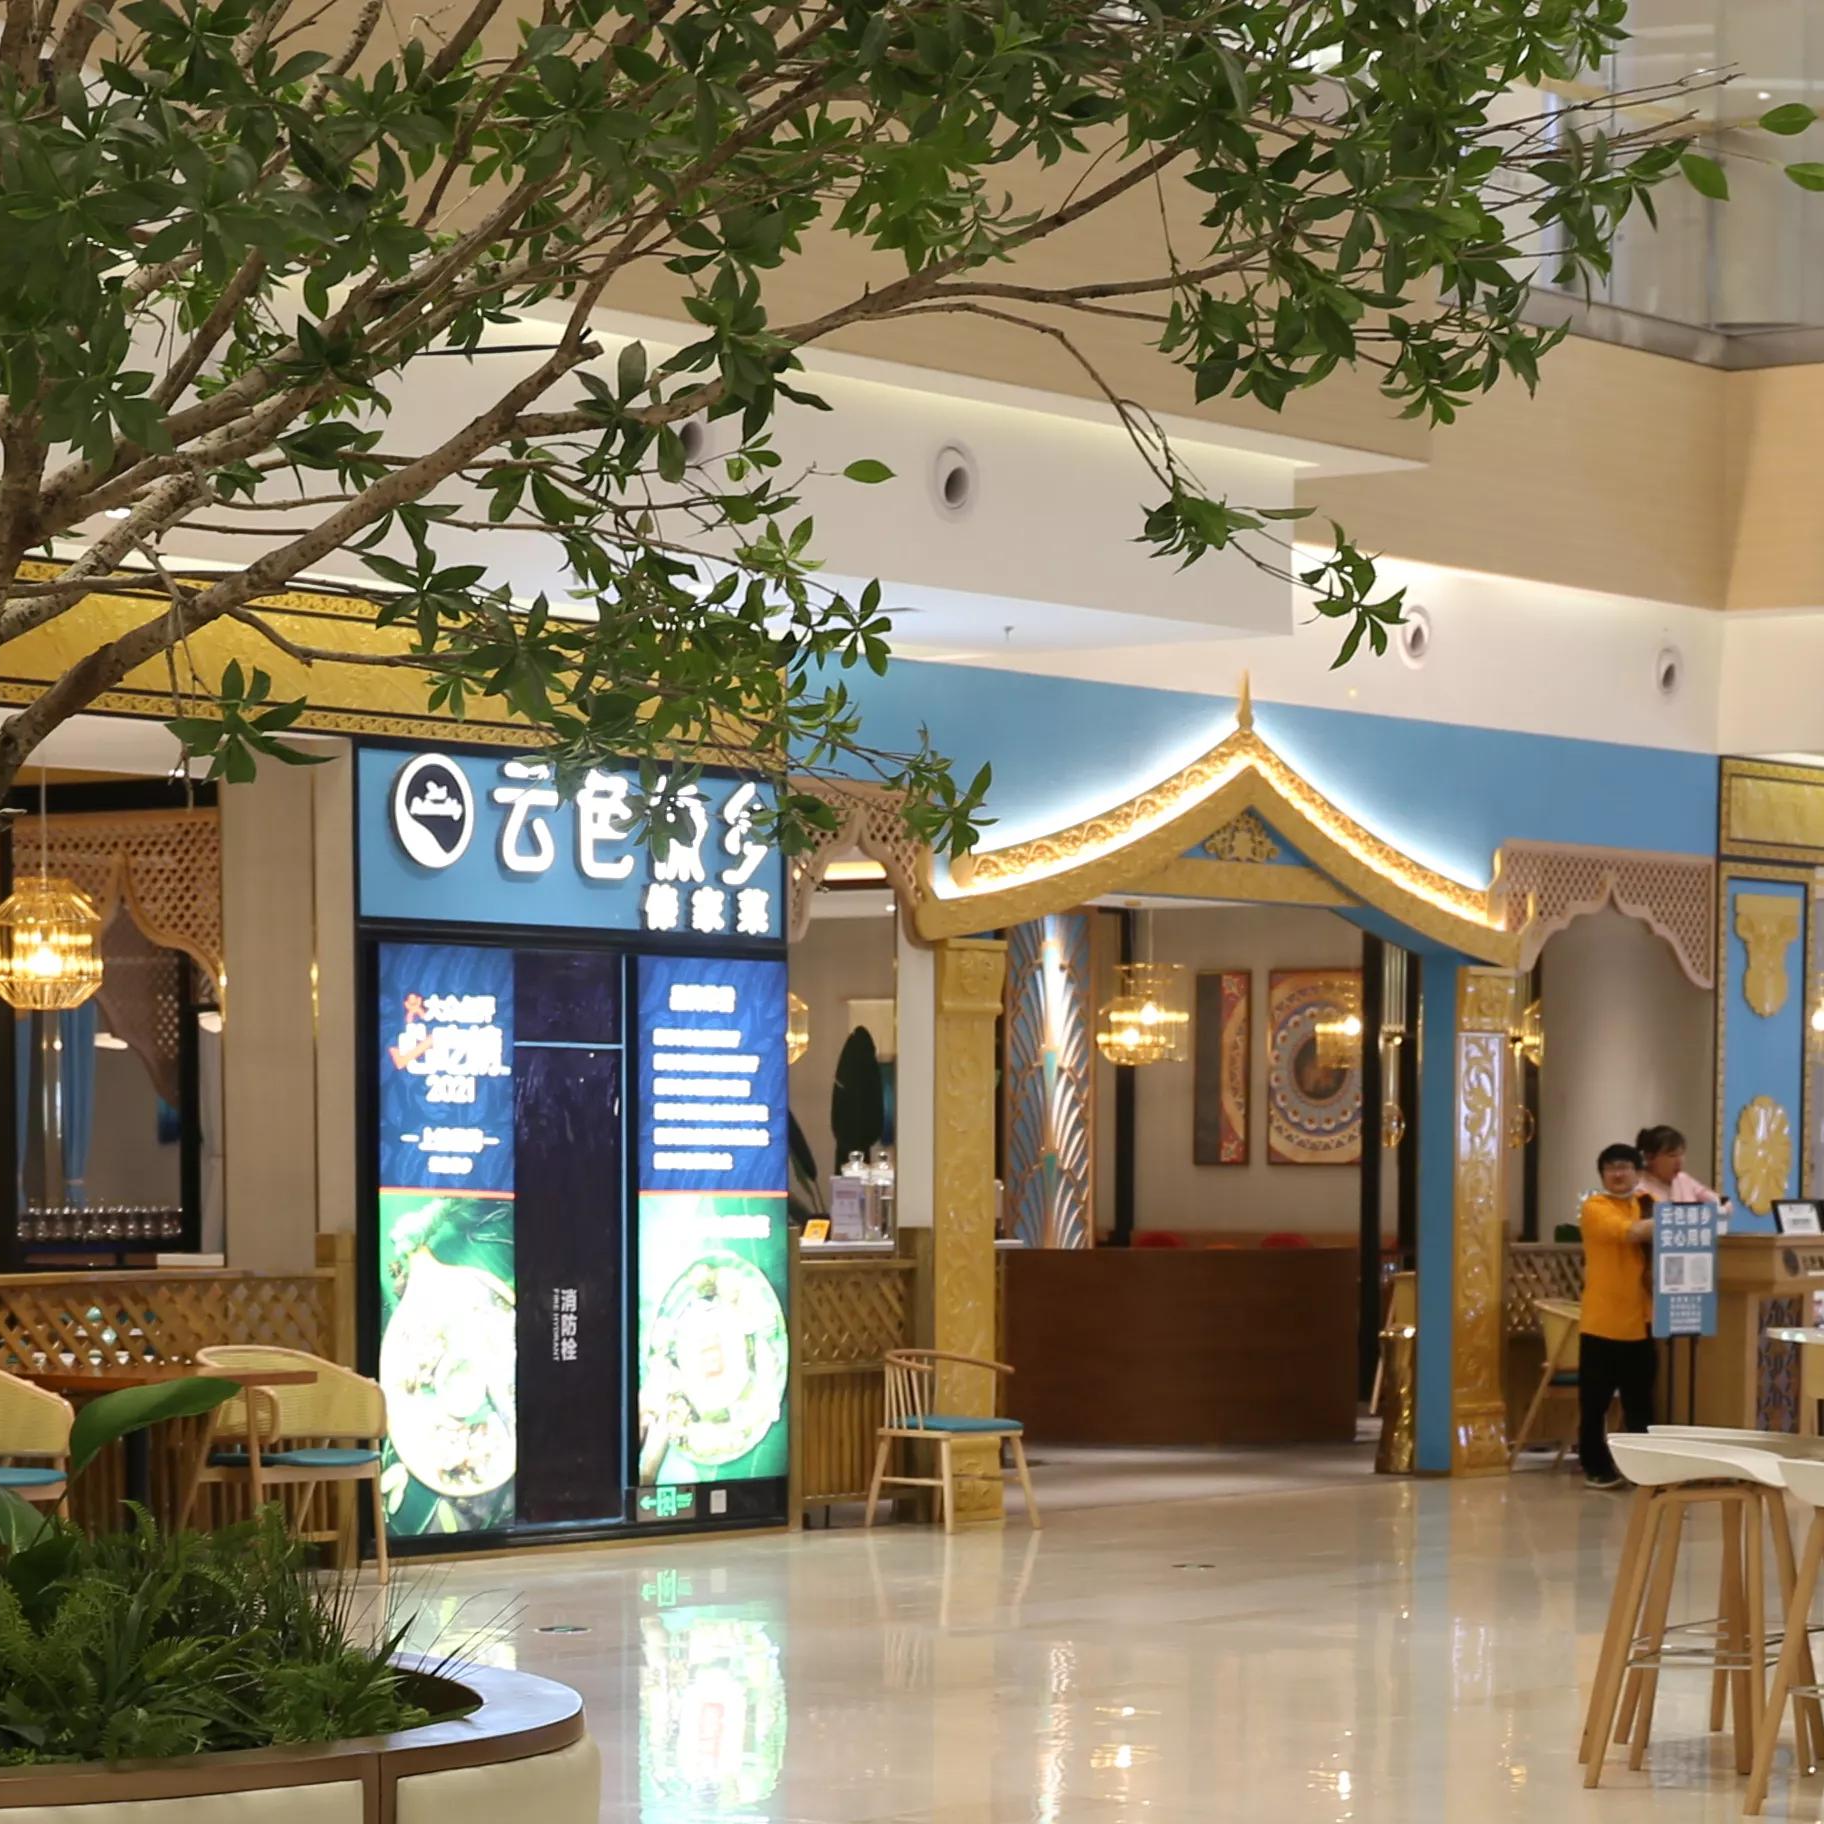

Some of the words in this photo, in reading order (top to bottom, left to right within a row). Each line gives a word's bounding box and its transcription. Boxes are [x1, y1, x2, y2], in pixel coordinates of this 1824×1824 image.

[552, 1288, 560, 1312] FIRE
[552, 1313, 560, 1362] HYDRANT
[561, 1289, 578, 1361] 消防栓
